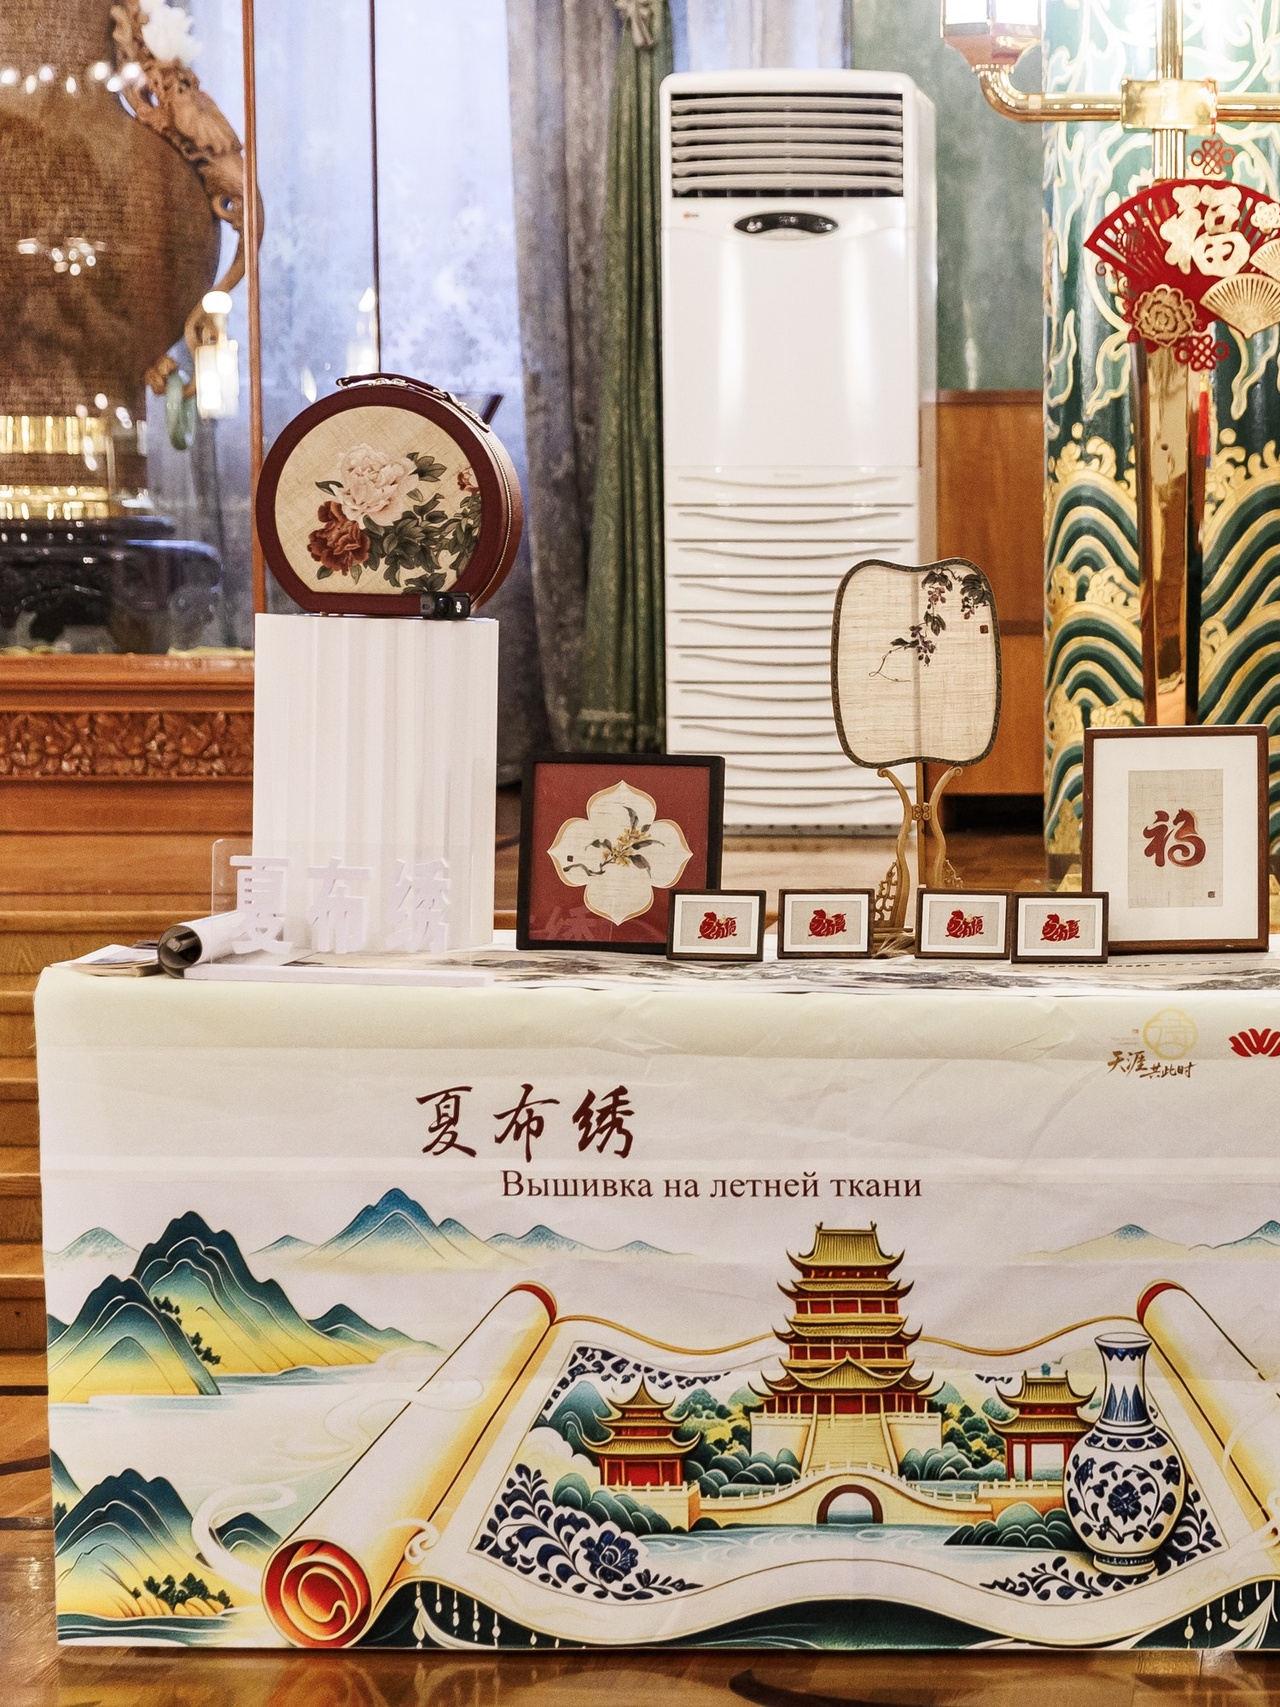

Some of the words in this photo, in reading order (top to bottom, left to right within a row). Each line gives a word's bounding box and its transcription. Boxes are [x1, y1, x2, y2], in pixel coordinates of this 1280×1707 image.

[1159, 184, 1251, 277] 福
[229, 855, 450, 955] 夏布绣
[416, 1083, 635, 1163] 夏布绣
[500, 1170, 654, 1198] Вышивка
[664, 1178, 701, 1198] на
[710, 1171, 820, 1198] летней
[830, 1178, 922, 1198] ткани
